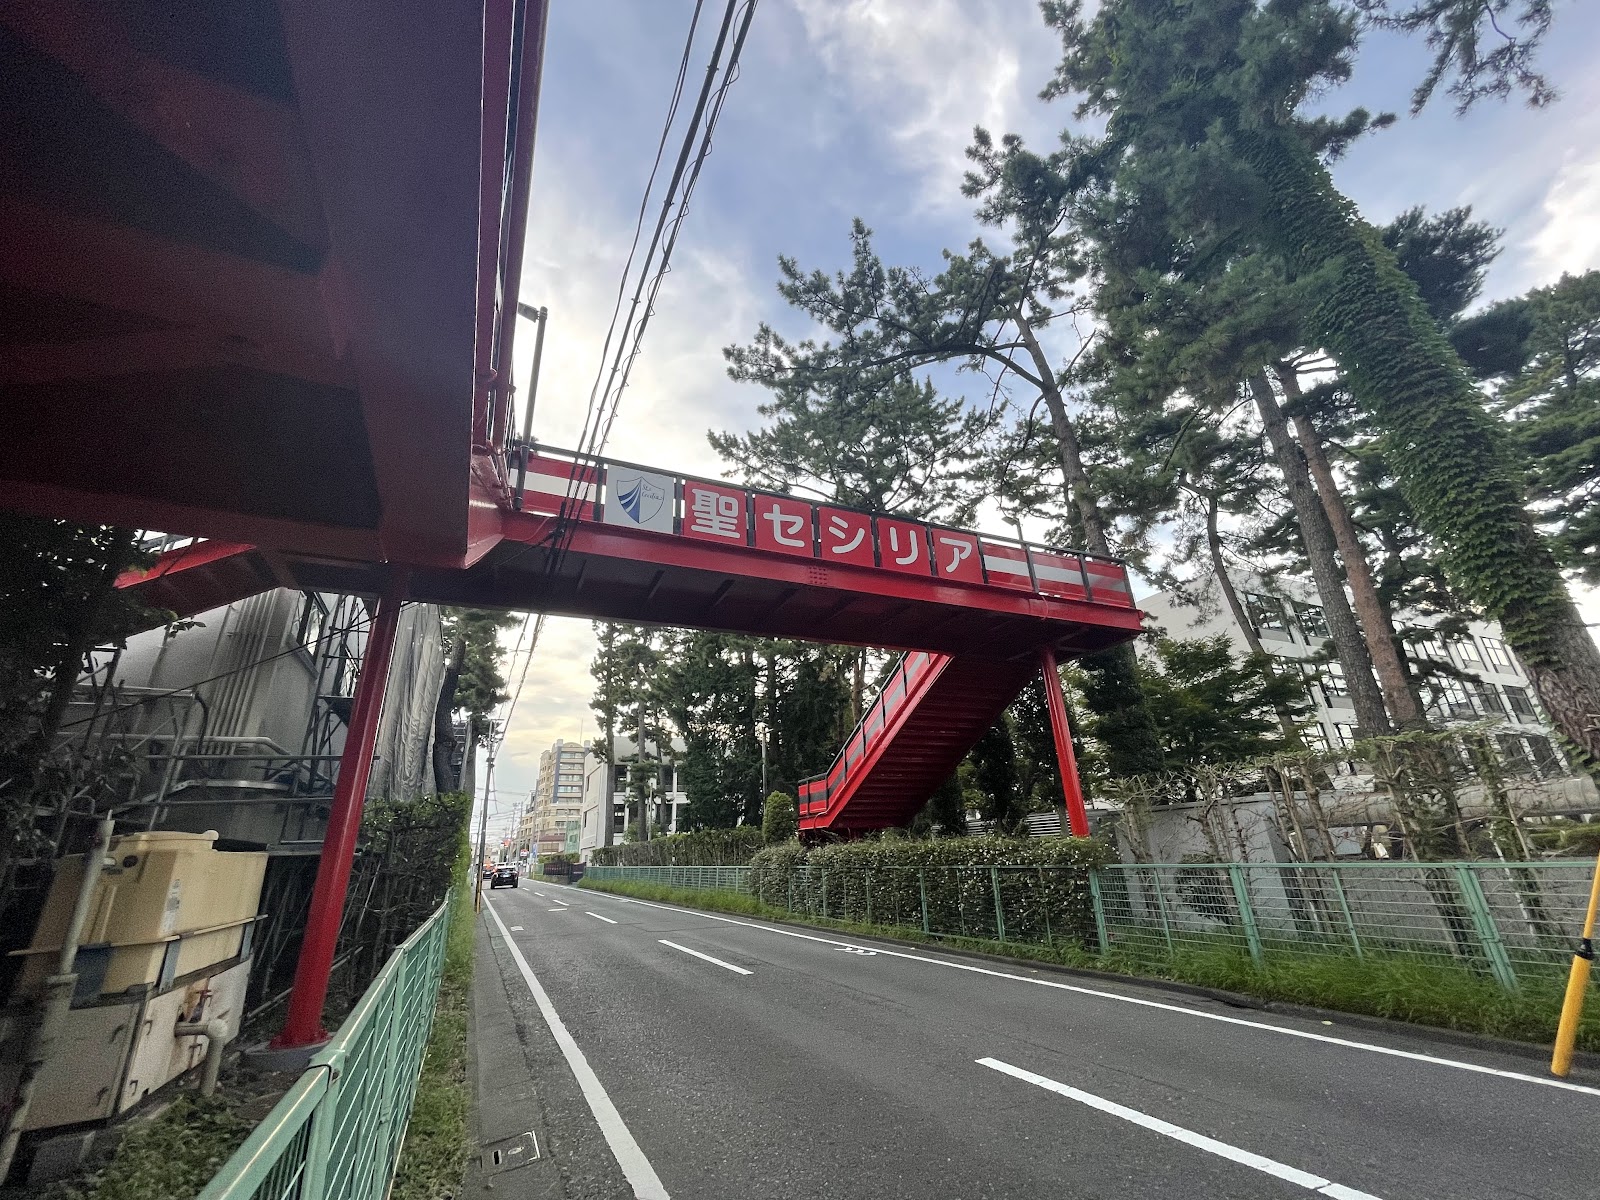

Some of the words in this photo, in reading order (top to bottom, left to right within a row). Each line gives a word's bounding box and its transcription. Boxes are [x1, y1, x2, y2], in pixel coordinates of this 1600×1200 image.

[691, 488, 972, 573] 聖セシリア
